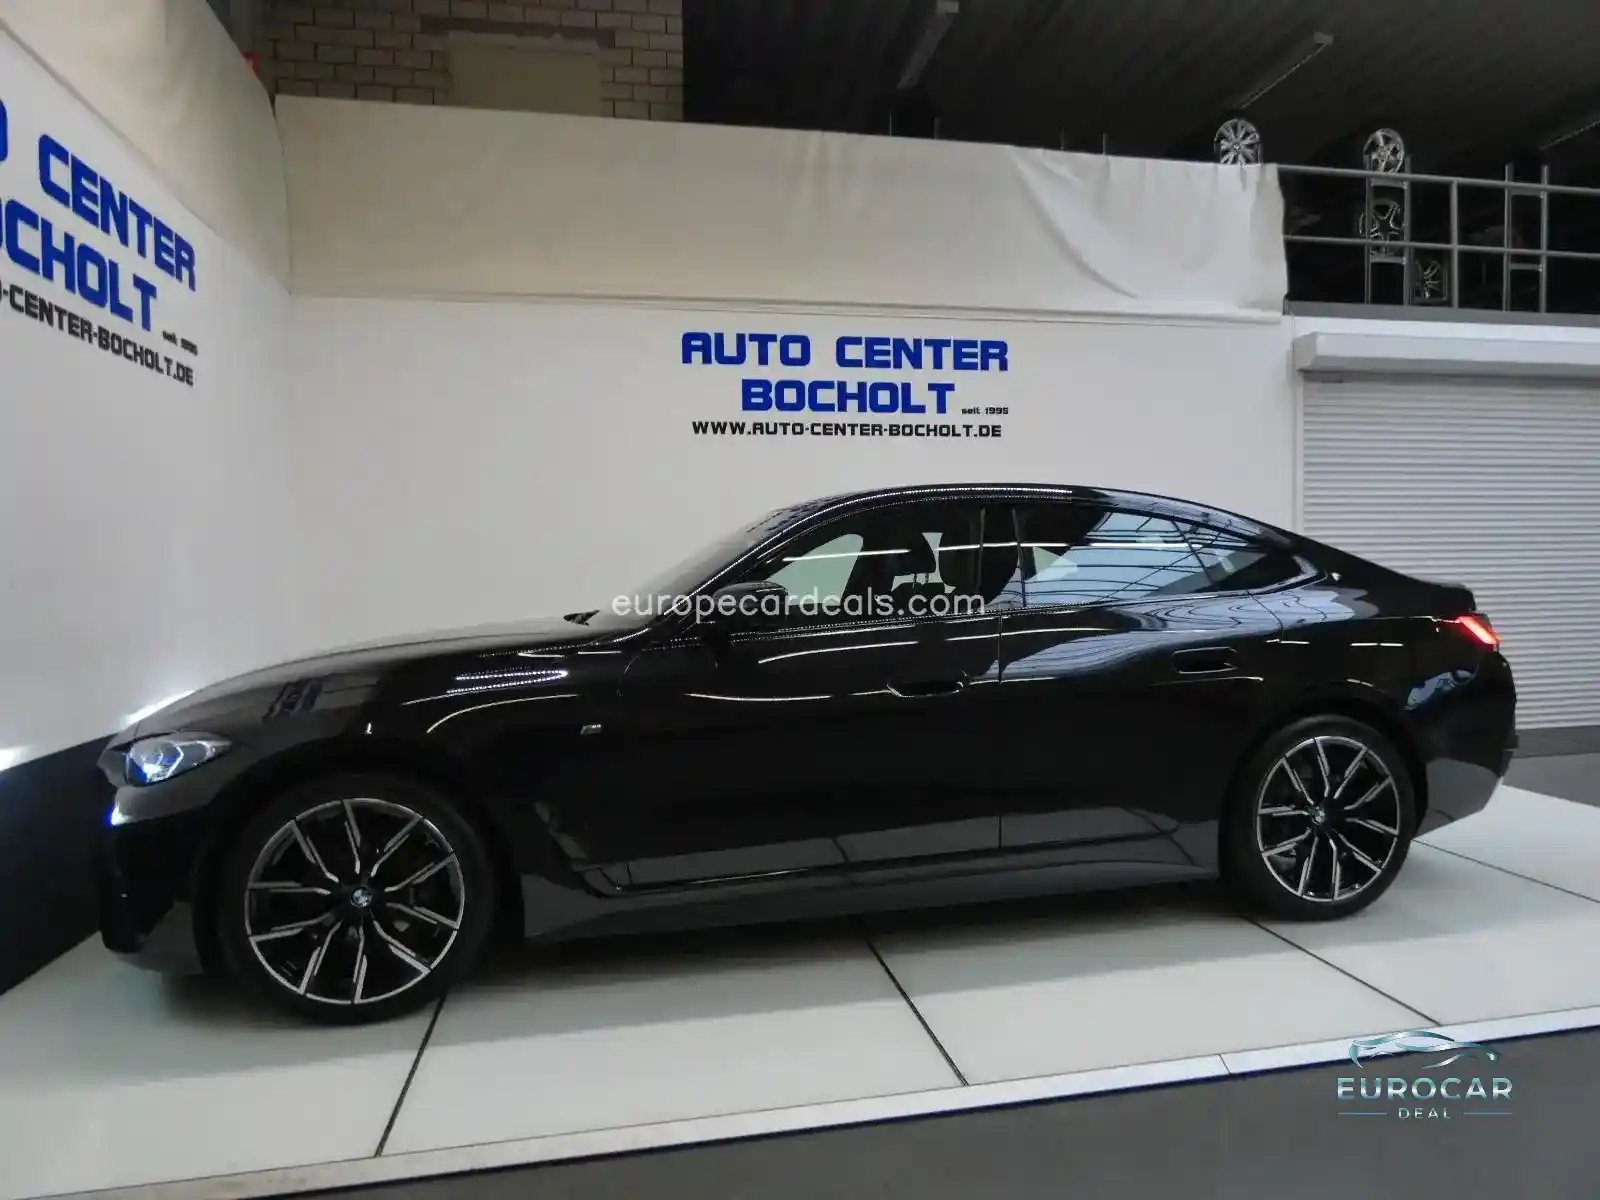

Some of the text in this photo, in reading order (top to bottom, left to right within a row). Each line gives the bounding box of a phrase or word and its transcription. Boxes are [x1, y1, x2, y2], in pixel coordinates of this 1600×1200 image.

[38, 133, 196, 292] CENTER
[0, 197, 157, 332] CHOLT
[0, 279, 194, 387] -CENTER-BOCHOLT.DE
[682, 331, 1009, 371] AUTO CENTER
[741, 378, 955, 414] BOCHOLT
[984, 406, 1009, 415] 1995
[692, 420, 1002, 438] WWW.AUTO-CENTER-BOCHOLT.DE
